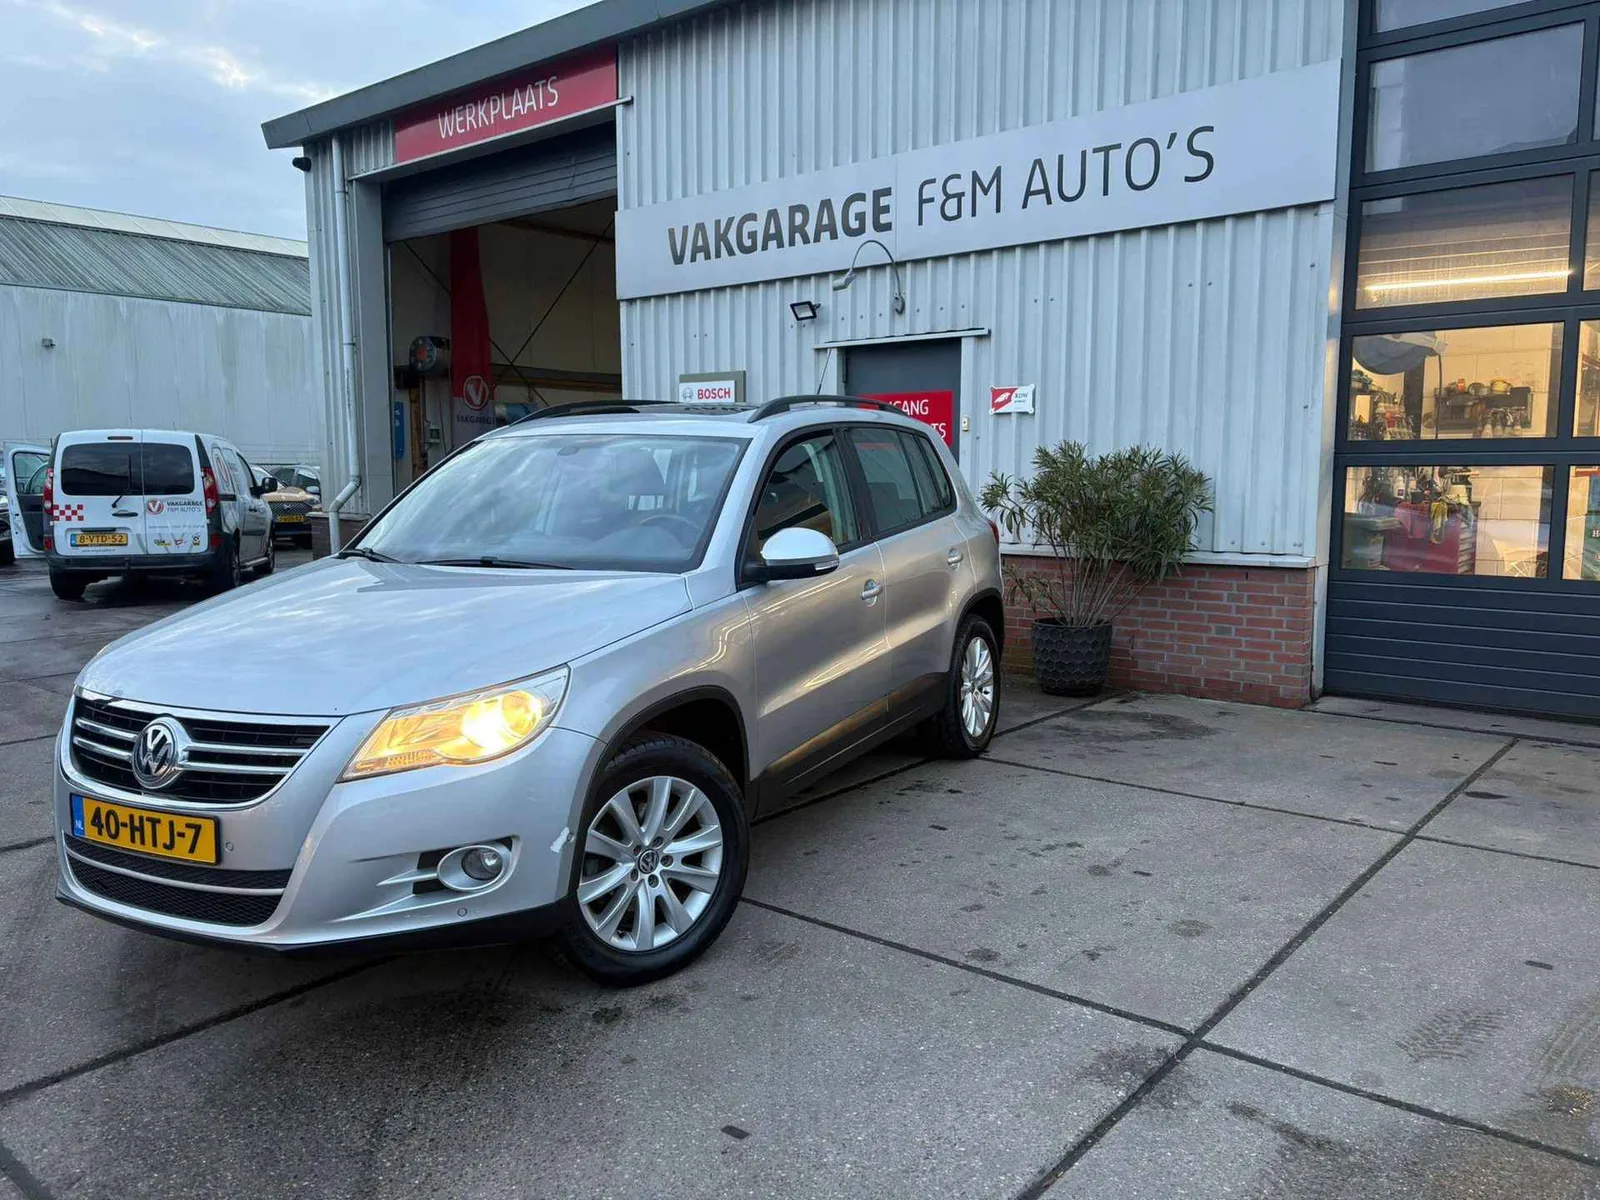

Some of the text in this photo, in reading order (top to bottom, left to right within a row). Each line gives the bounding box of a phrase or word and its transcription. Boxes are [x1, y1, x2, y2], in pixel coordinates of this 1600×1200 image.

[437, 76, 559, 139] WERKPLAATS
[667, 125, 1215, 266] VAKGARAGE F&M AUTO'S
[697, 387, 731, 400] BOSCH
[90, 806, 202, 854] 40-HTJ-7
